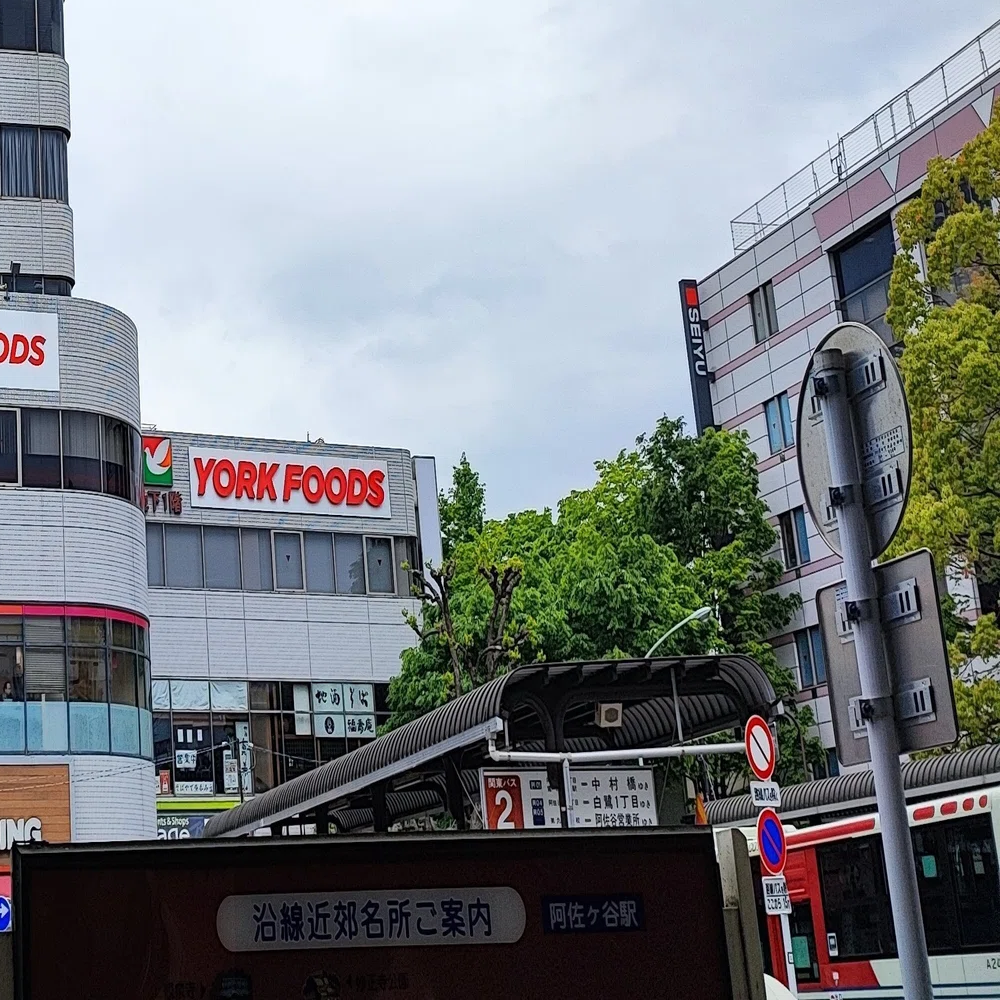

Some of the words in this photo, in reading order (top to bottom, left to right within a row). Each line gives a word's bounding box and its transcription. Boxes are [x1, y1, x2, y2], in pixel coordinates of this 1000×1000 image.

[687, 307, 707, 377] SEIYU
[193, 457, 281, 501] YORK
[283, 464, 387, 508] FOODS
[487, 777, 517, 789] 関東バス
[495, 789, 515, 829] 2
[253, 897, 493, 943] 沿線近郊名所ご案内
